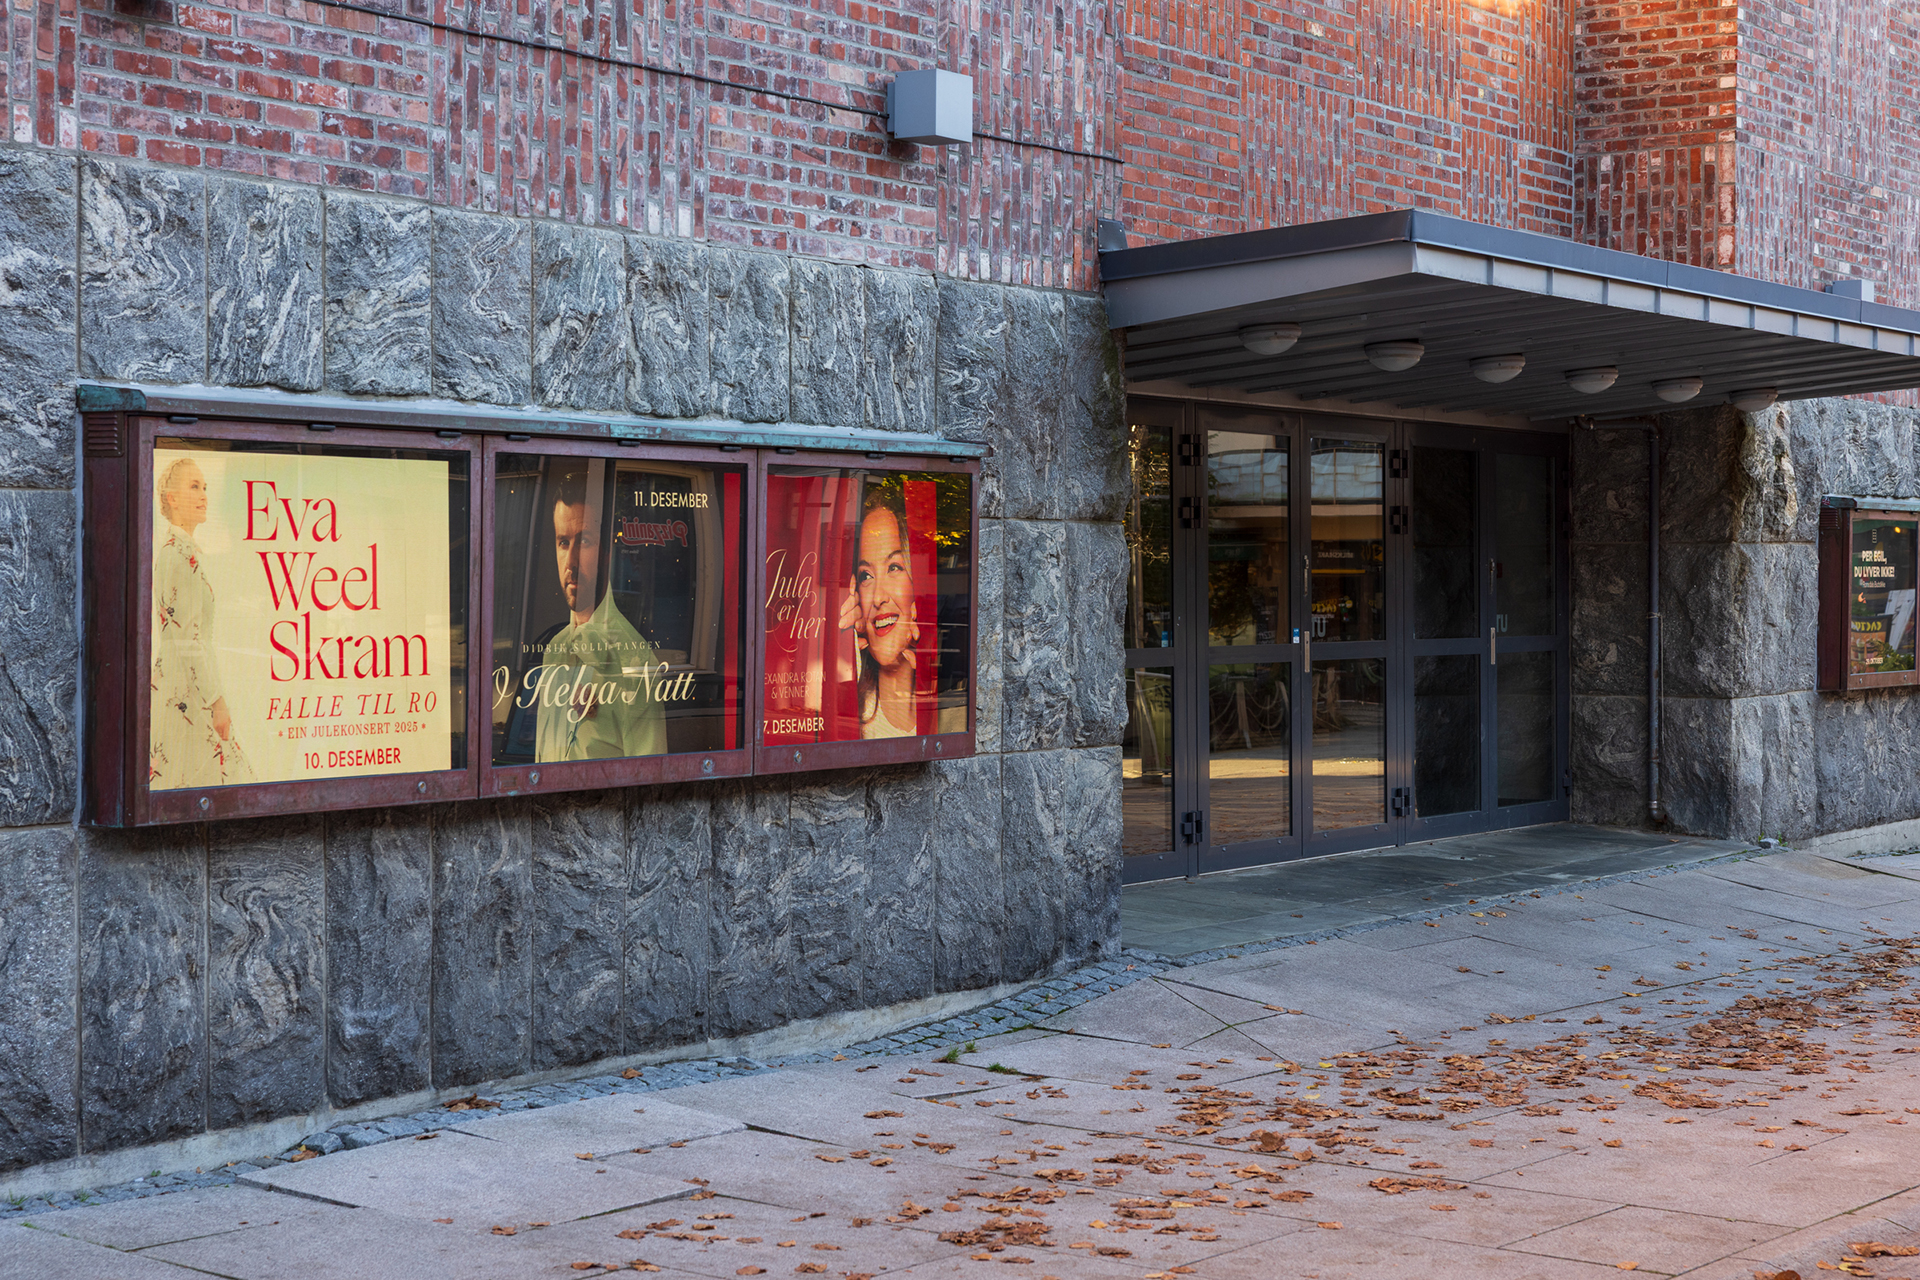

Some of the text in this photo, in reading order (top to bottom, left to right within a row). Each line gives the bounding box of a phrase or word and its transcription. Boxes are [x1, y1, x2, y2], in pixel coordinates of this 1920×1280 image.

[633, 491, 709, 509] 11. DESEMBER
[242, 480, 342, 542] Eva
[1861, 550, 1887, 564] PER EGIL,
[256, 543, 381, 612] Weel
[1854, 566, 1863, 577] DU
[1863, 566, 1880, 577] LYVER
[269, 611, 430, 682] Skram
[523, 643, 566, 653] DIDRIK
[516, 664, 622, 724] Helga
[771, 685, 809, 699] & VENNER
[266, 690, 437, 720] FALLE TIL RO
[287, 720, 419, 740] EIN JULEKONSERT 2025
[772, 716, 825, 734] DESEMBER
[304, 747, 401, 769] 10. DESEMBER
